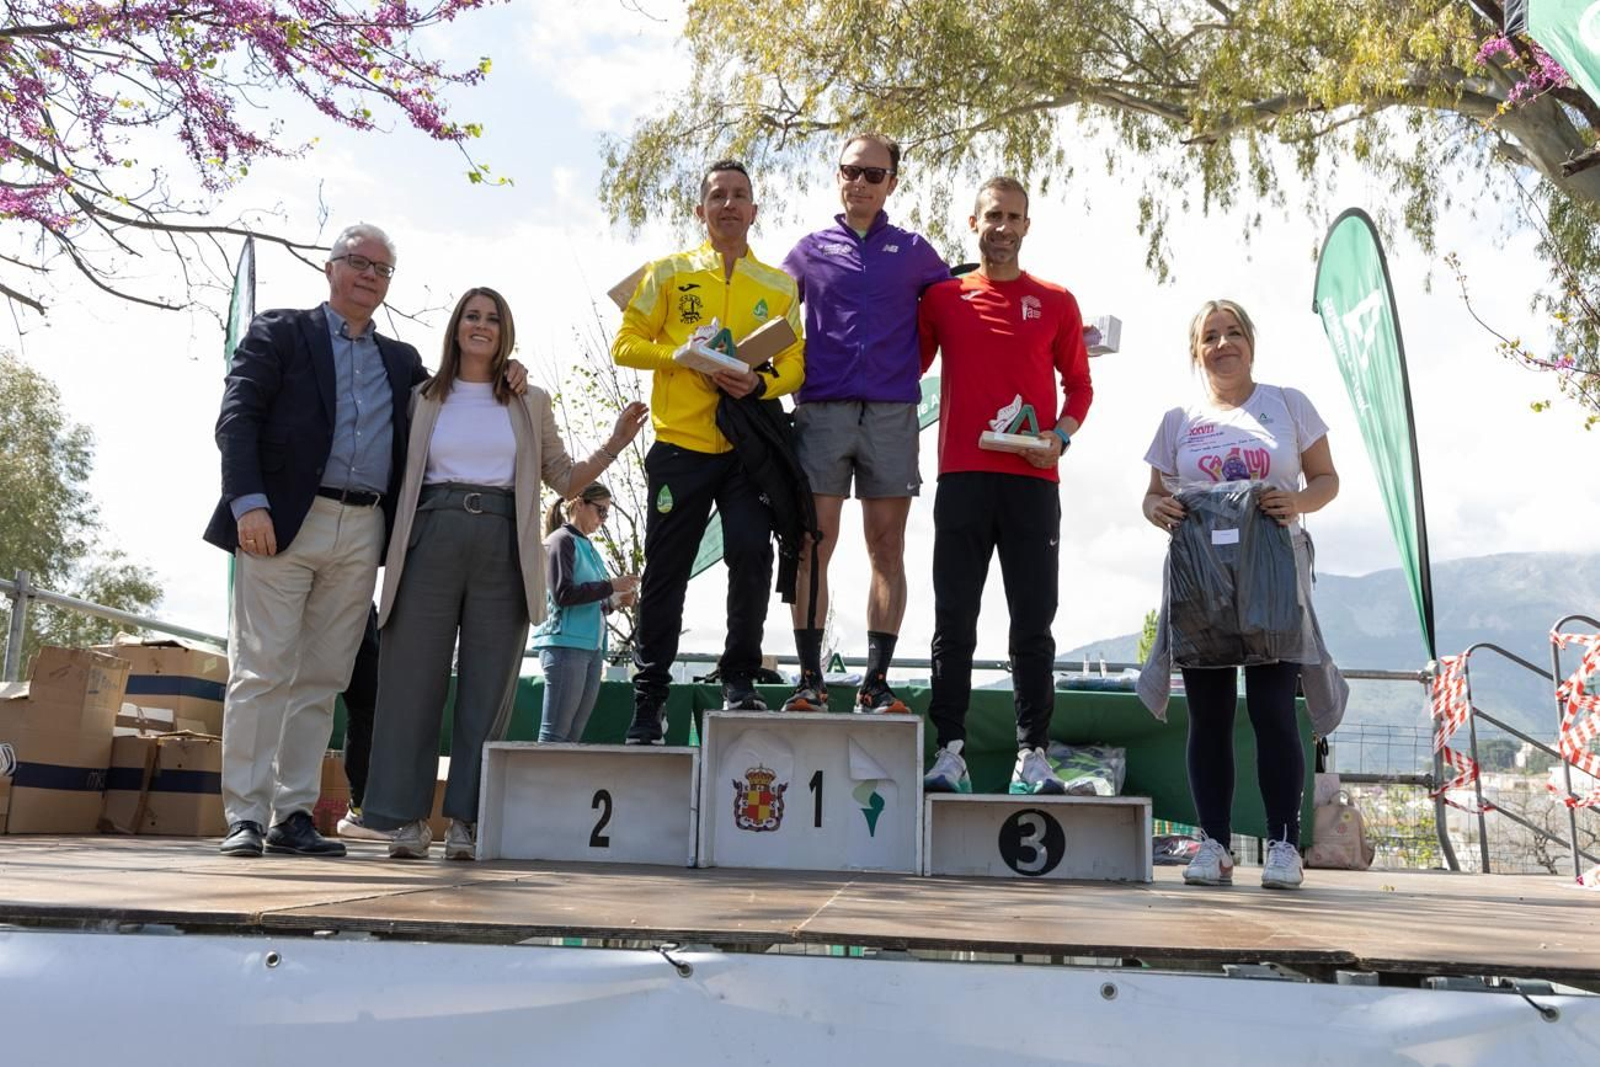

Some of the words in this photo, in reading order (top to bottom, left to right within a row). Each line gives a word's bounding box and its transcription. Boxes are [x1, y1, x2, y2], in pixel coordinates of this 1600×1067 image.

[589, 789, 613, 848] 2
[809, 770, 823, 828] 1
[1016, 812, 1048, 872] 3
